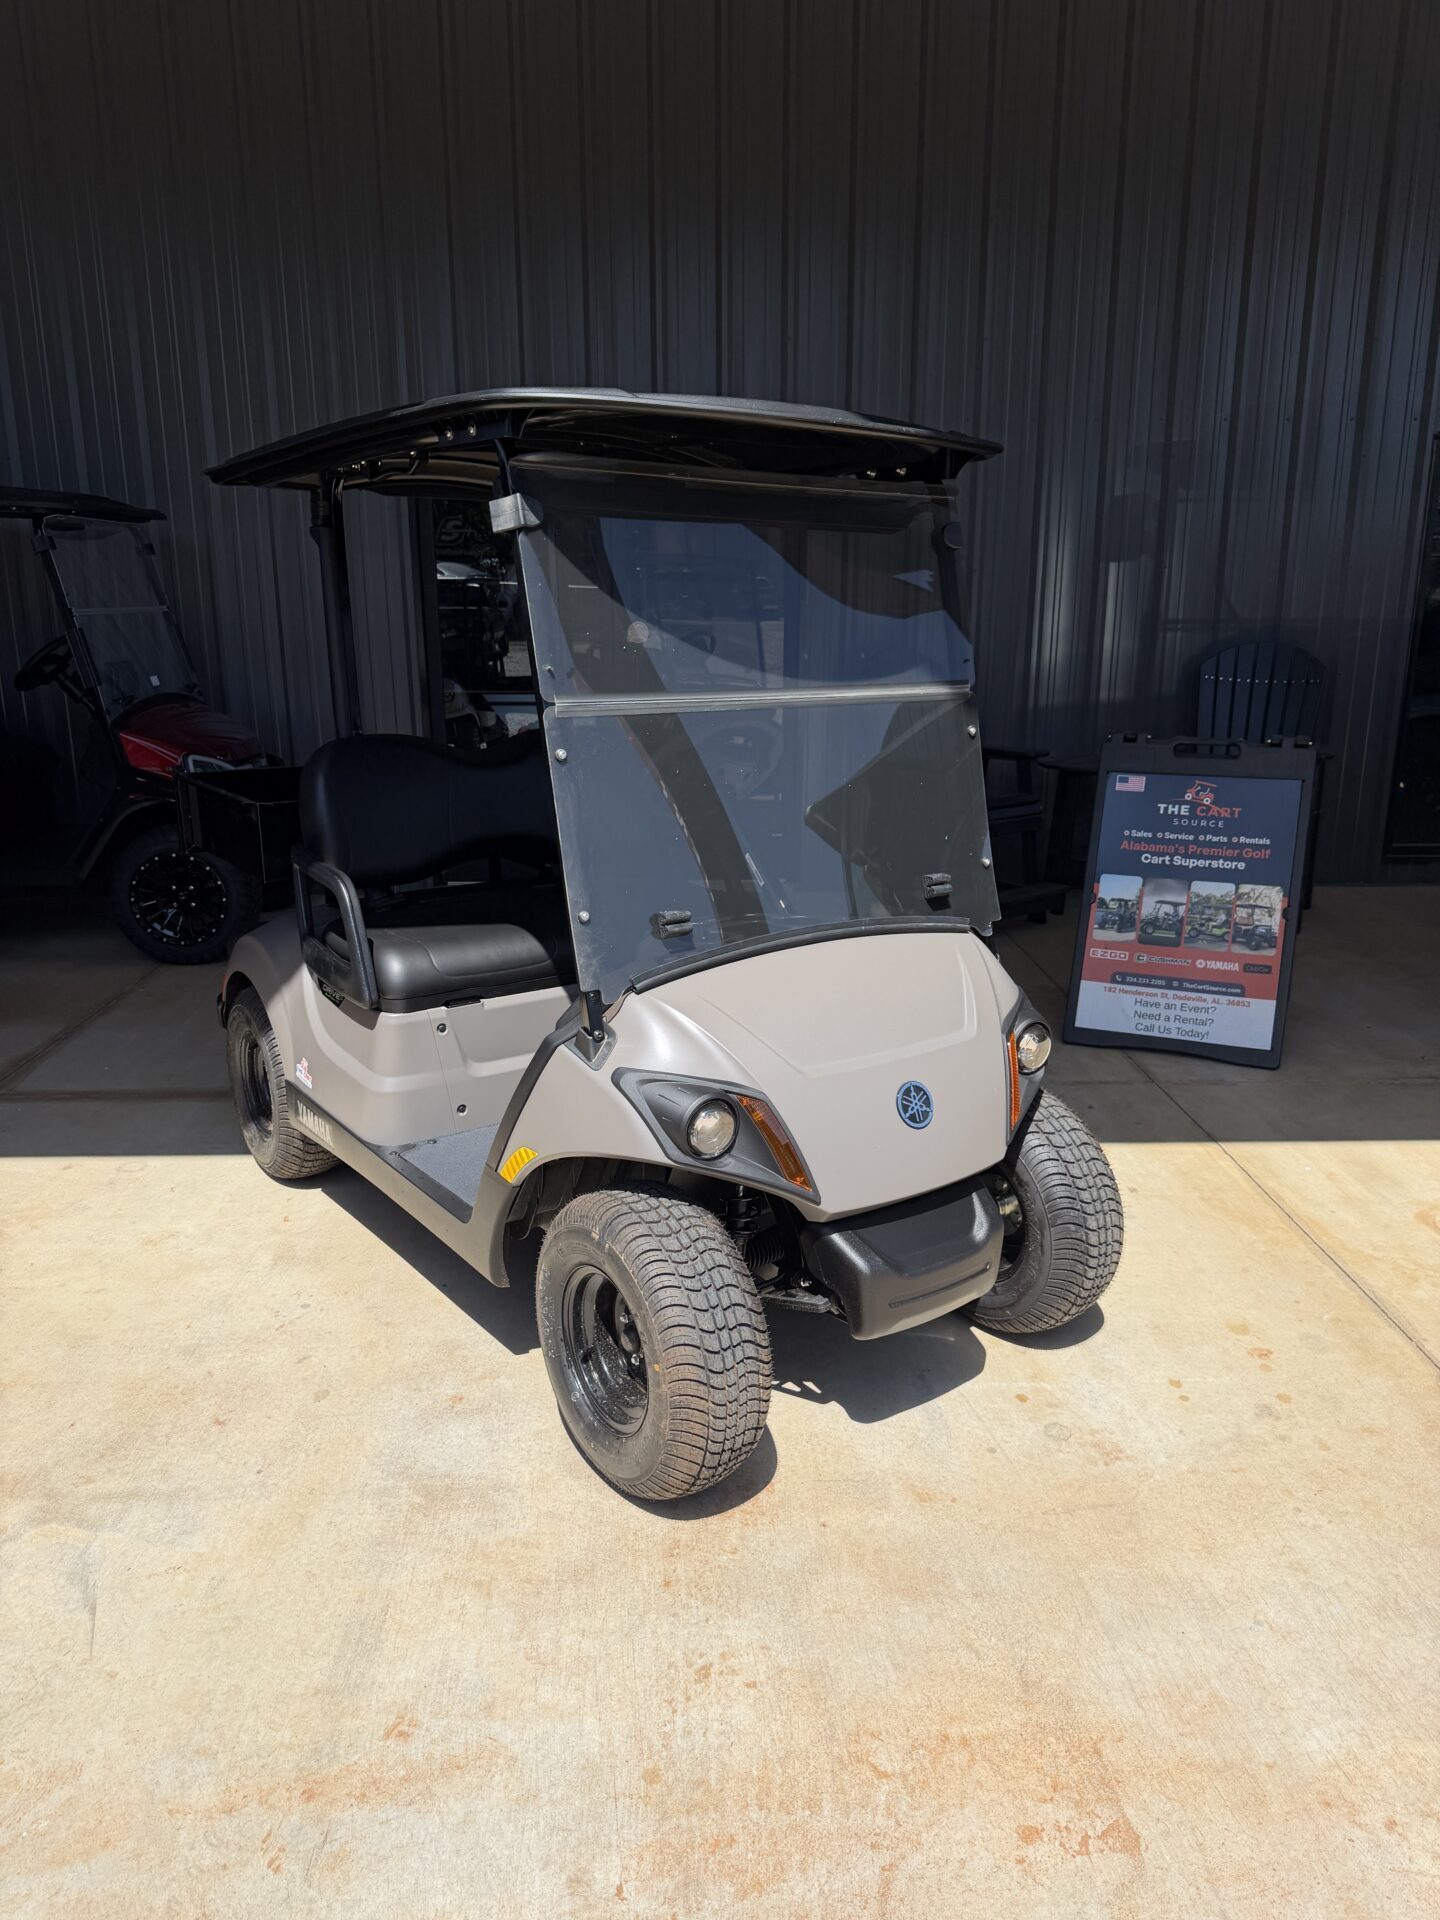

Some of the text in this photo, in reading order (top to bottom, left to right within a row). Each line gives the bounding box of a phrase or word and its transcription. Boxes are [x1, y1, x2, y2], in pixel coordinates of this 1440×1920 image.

[1157, 803, 1242, 818] THE CART
[1172, 818, 1224, 828] SOURCE
[1130, 829, 1271, 845] Sales Service Parts Rentals
[1120, 840, 1271, 860] Alabama's Premier Golf
[1141, 853, 1246, 870] Cart Superstore
[1206, 960, 1239, 972] YAMAHA
[1118, 987, 1159, 998] Henderson
[1134, 998, 1217, 1015] Have an Event?
[1133, 1010, 1214, 1027] Need a Rental?
[1135, 1022, 1209, 1040] Call Us Today!
[297, 1099, 333, 1149] YAMAHA
